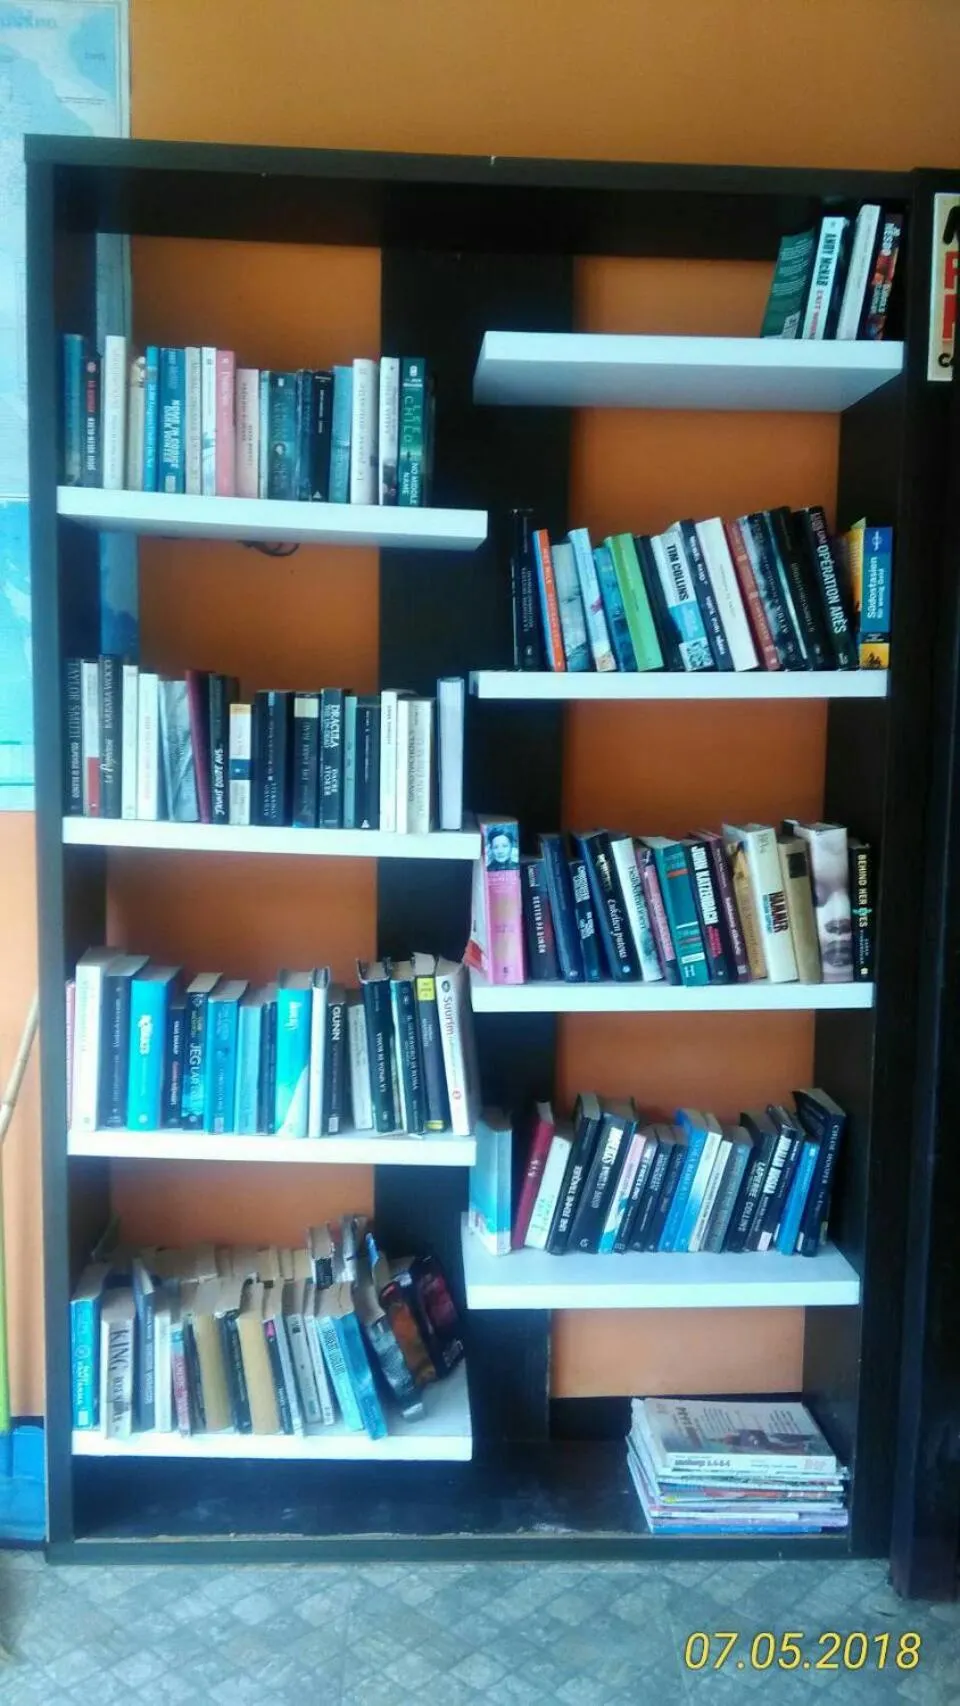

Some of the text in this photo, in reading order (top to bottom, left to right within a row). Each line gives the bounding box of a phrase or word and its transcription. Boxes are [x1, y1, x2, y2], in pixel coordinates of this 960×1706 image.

[815, 232, 837, 286] ANDY McNAB
[402, 396, 413, 443] CHILD
[411, 402, 421, 433] LEE
[162, 430, 172, 464] WINTER
[401, 472, 411, 496] NAME
[409, 463, 419, 505] NO MIDDLE
[665, 543, 693, 601] TIM COLLINS
[815, 543, 849, 634] OPÉRATION ARÈS
[867, 556, 878, 618] Südostasien
[877, 586, 885, 606] wenig
[67, 662, 81, 738] TAYLOR SMITH
[104, 658, 112, 728] BARBARA WOOD
[330, 704, 340, 747] DRACULA
[689, 844, 708, 870] JOHN
[857, 854, 867, 886] BEHIND
[693, 869, 720, 925] KATZENBACH
[858, 887, 867, 905] HER
[330, 1006, 340, 1040] GUNN
[189, 1042, 201, 1064] JEG
[557, 1217, 569, 1232] UNE
[737, 1200, 754, 1233] COLLINS
[109, 1329, 129, 1371] KING
